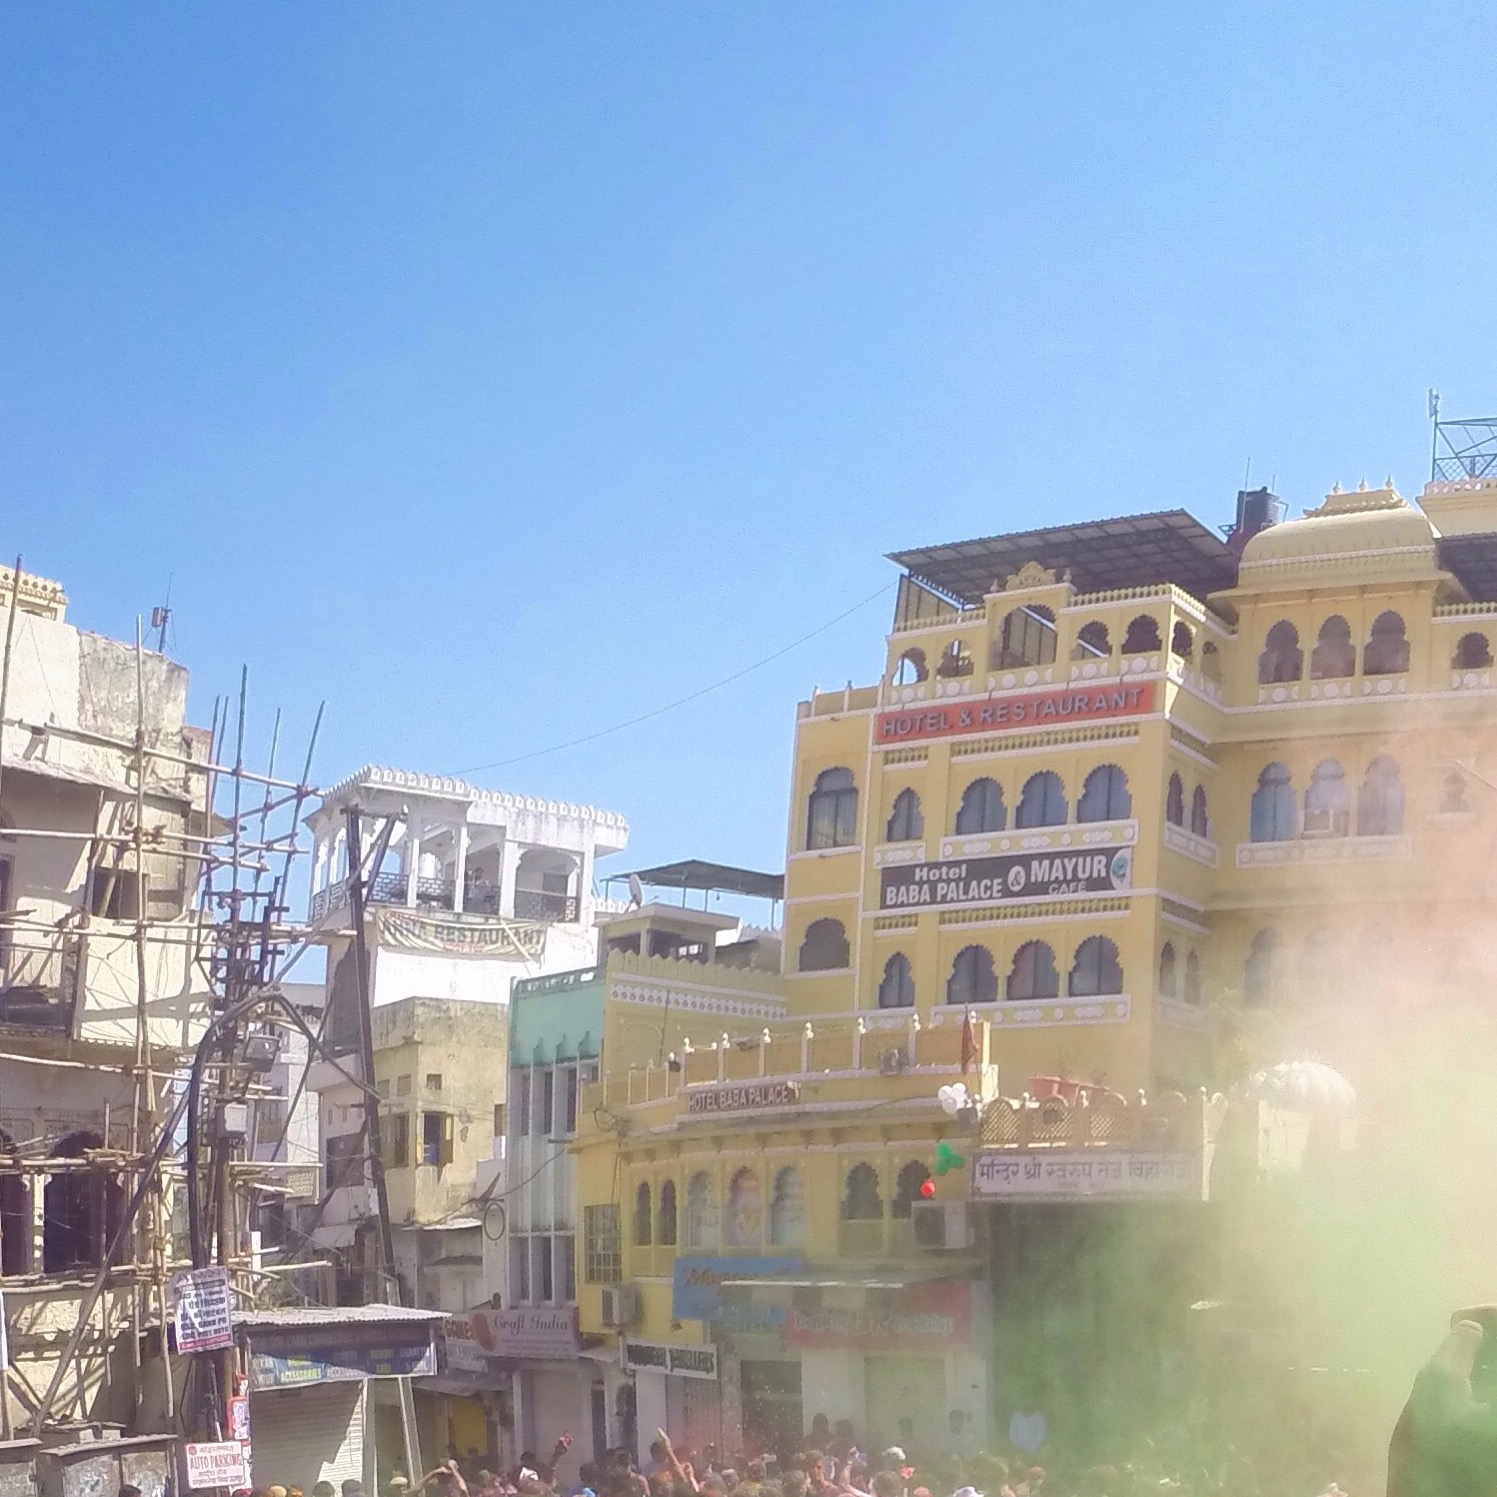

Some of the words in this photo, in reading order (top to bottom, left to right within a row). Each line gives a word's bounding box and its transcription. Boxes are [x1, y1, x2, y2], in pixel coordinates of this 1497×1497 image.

[883, 712, 950, 736] HOTEL
[959, 708, 972, 727] &
[980, 689, 1143, 723] RESTAURANT
[886, 884, 931, 906] BABA
[936, 878, 1003, 902] PALACE
[1030, 854, 1107, 883] MAYUR
[914, 863, 967, 882] Hotel
[435, 924, 544, 946] RESTAURANT
[688, 1092, 718, 1112] HOTEL
[720, 1089, 747, 1108] BABA
[749, 1084, 789, 1106] PALACE
[1023, 1157, 1042, 1181] श्री
